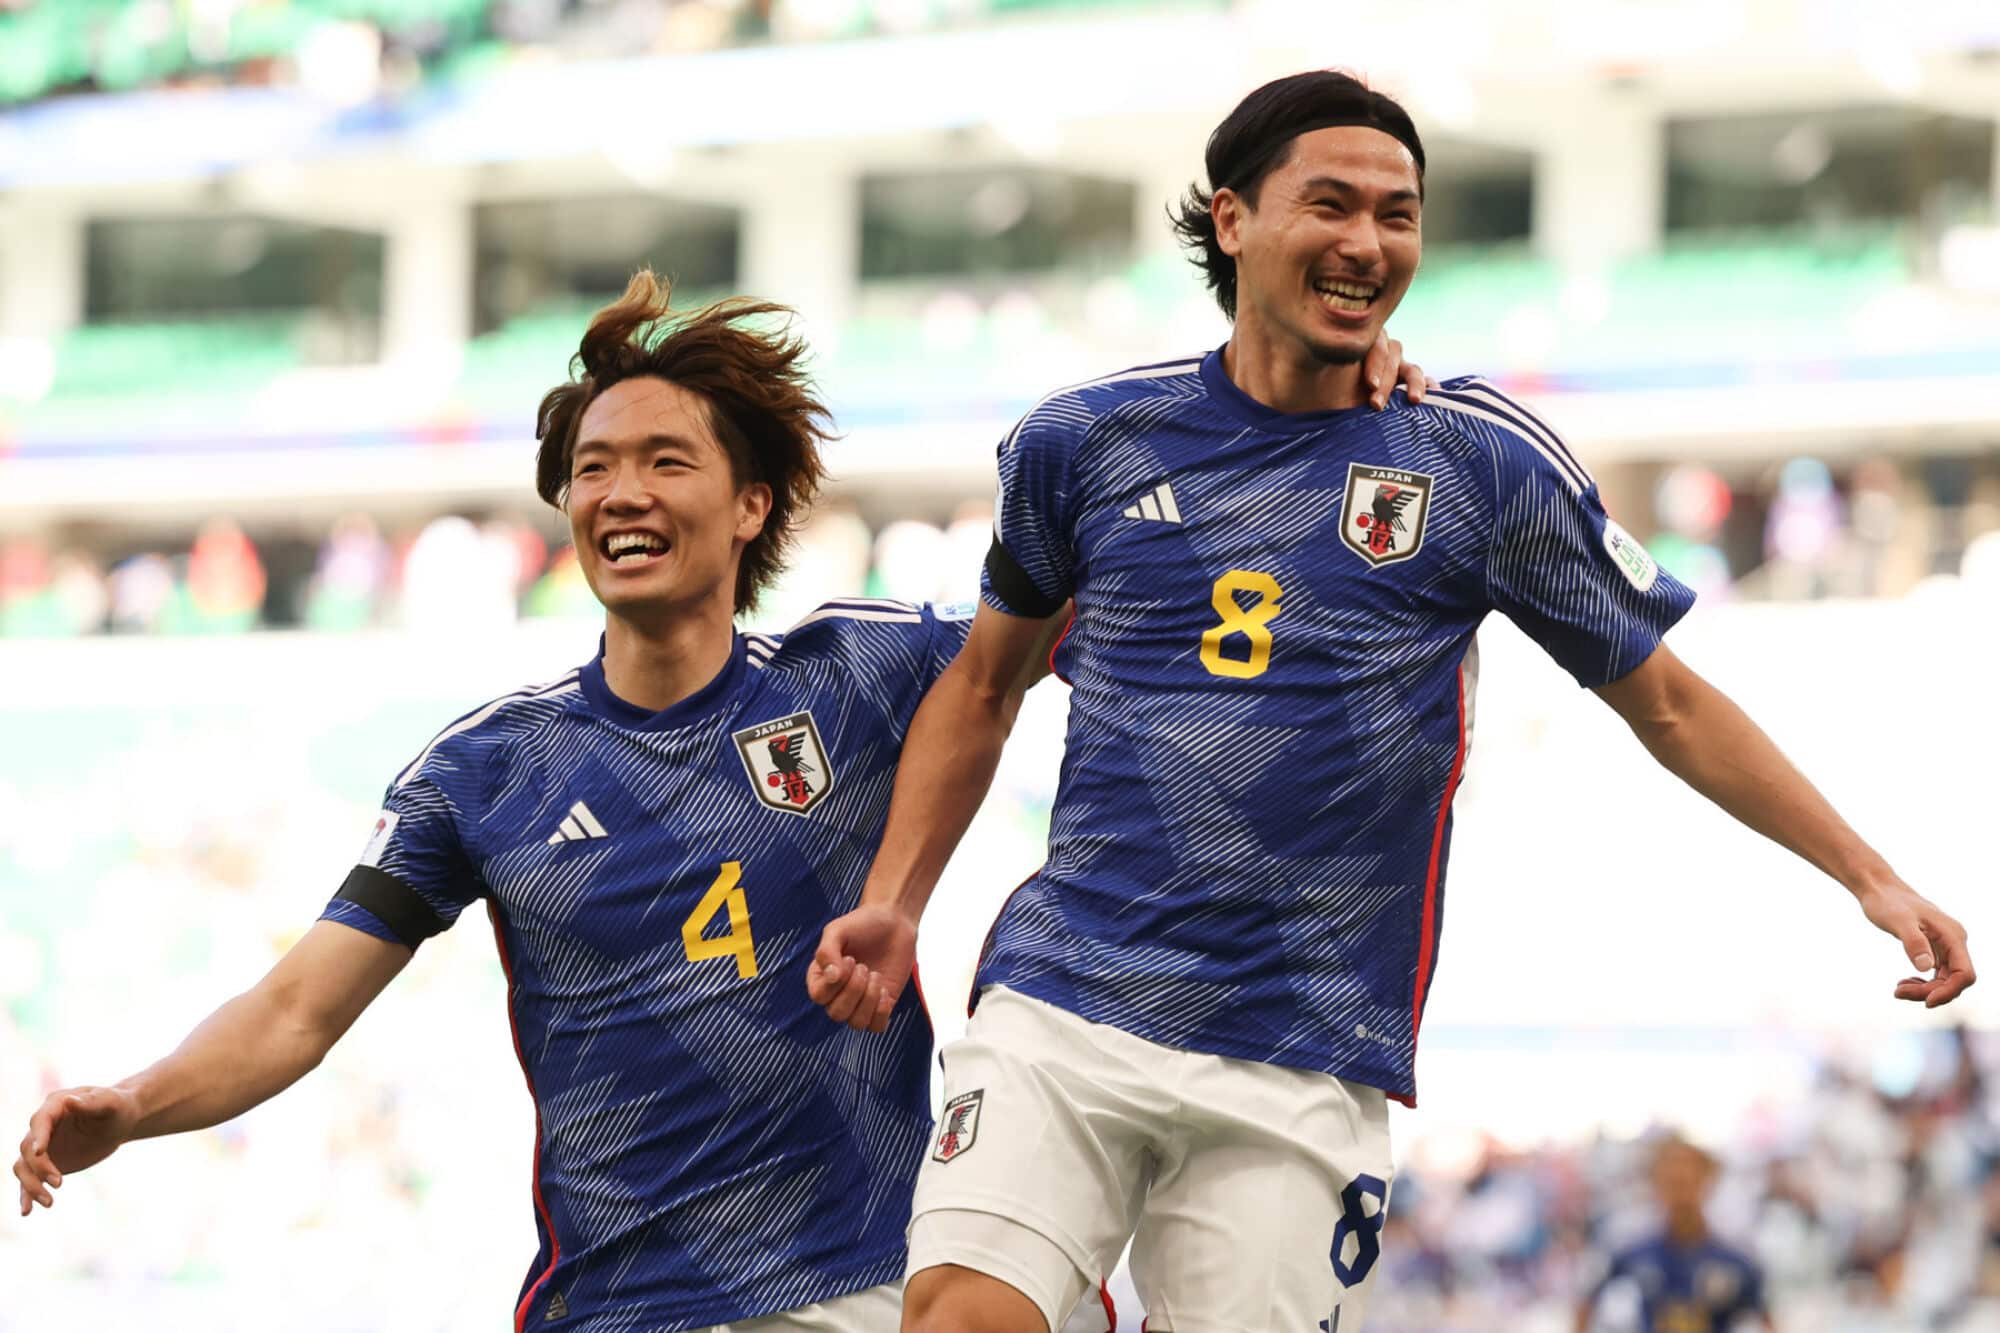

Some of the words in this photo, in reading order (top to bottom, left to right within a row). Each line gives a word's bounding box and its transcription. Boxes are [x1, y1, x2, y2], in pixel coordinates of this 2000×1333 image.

[1370, 470, 1413, 484] JAPAN
[1200, 568, 1284, 680] 8
[754, 719, 794, 738] JAPAN
[682, 860, 758, 980] 4
[1329, 1172, 1387, 1290] 8
